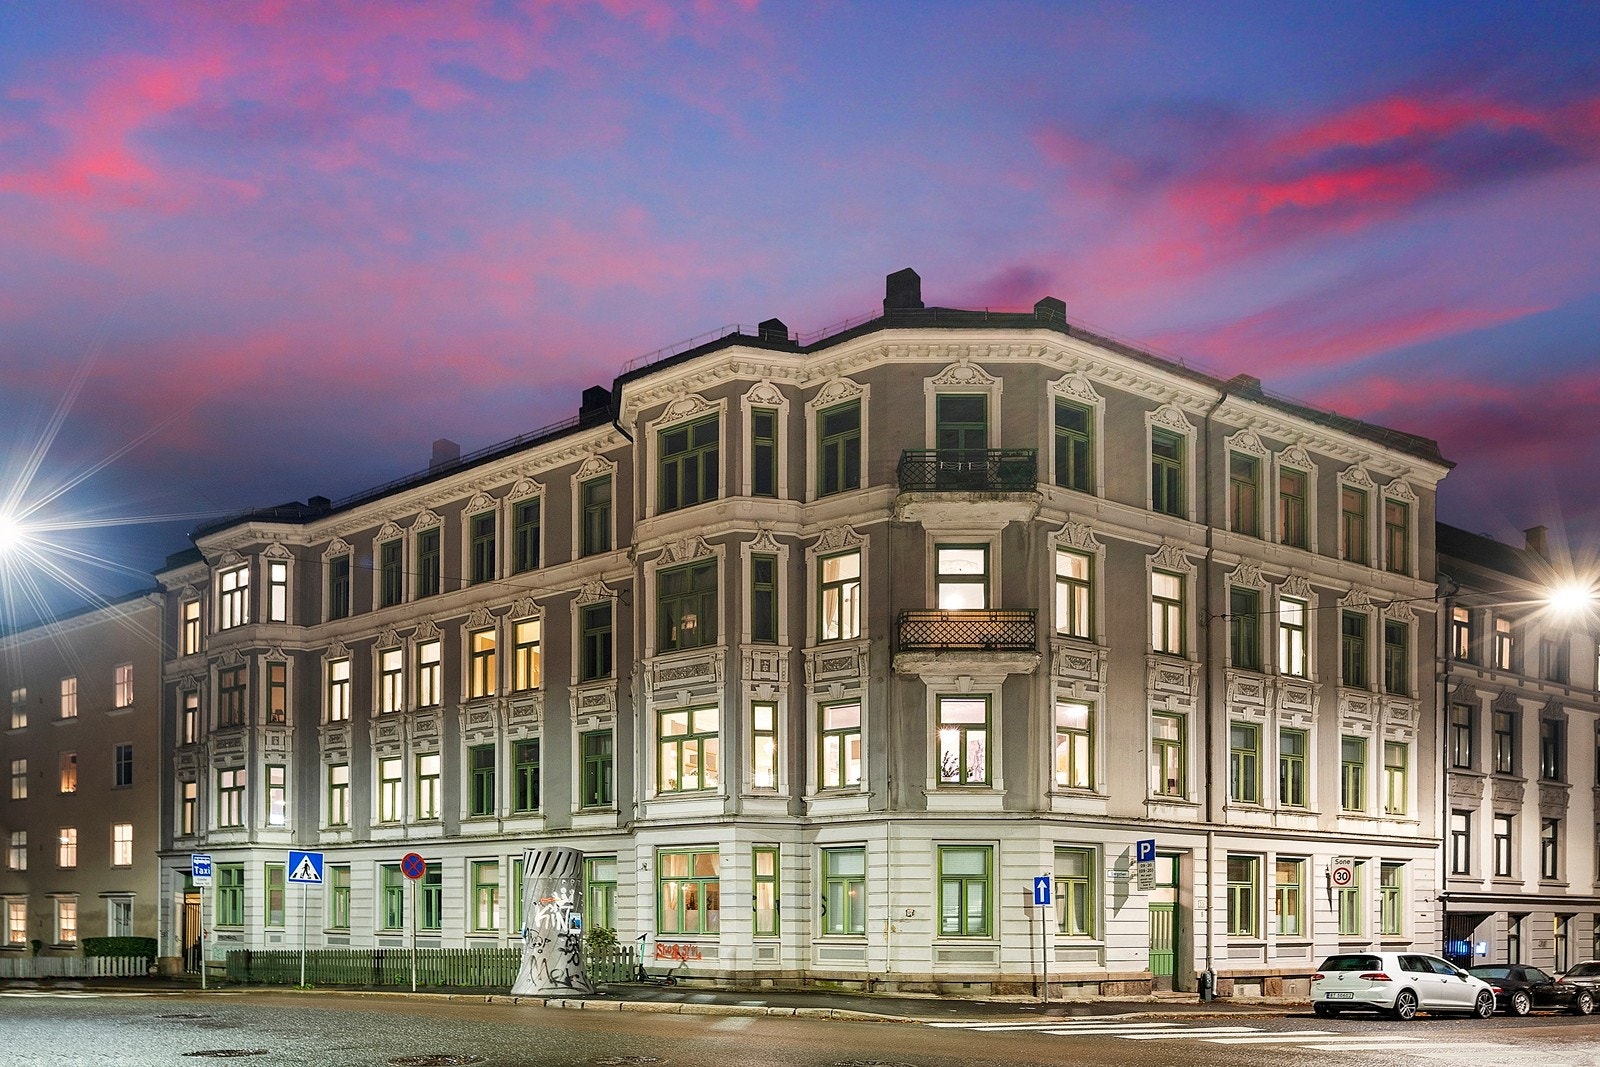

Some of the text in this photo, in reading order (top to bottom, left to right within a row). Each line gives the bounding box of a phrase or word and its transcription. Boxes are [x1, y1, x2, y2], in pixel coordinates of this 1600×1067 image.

[1141, 843, 1151, 860] P
[194, 866, 210, 874] Taxi
[1336, 872, 1348, 880] 30
